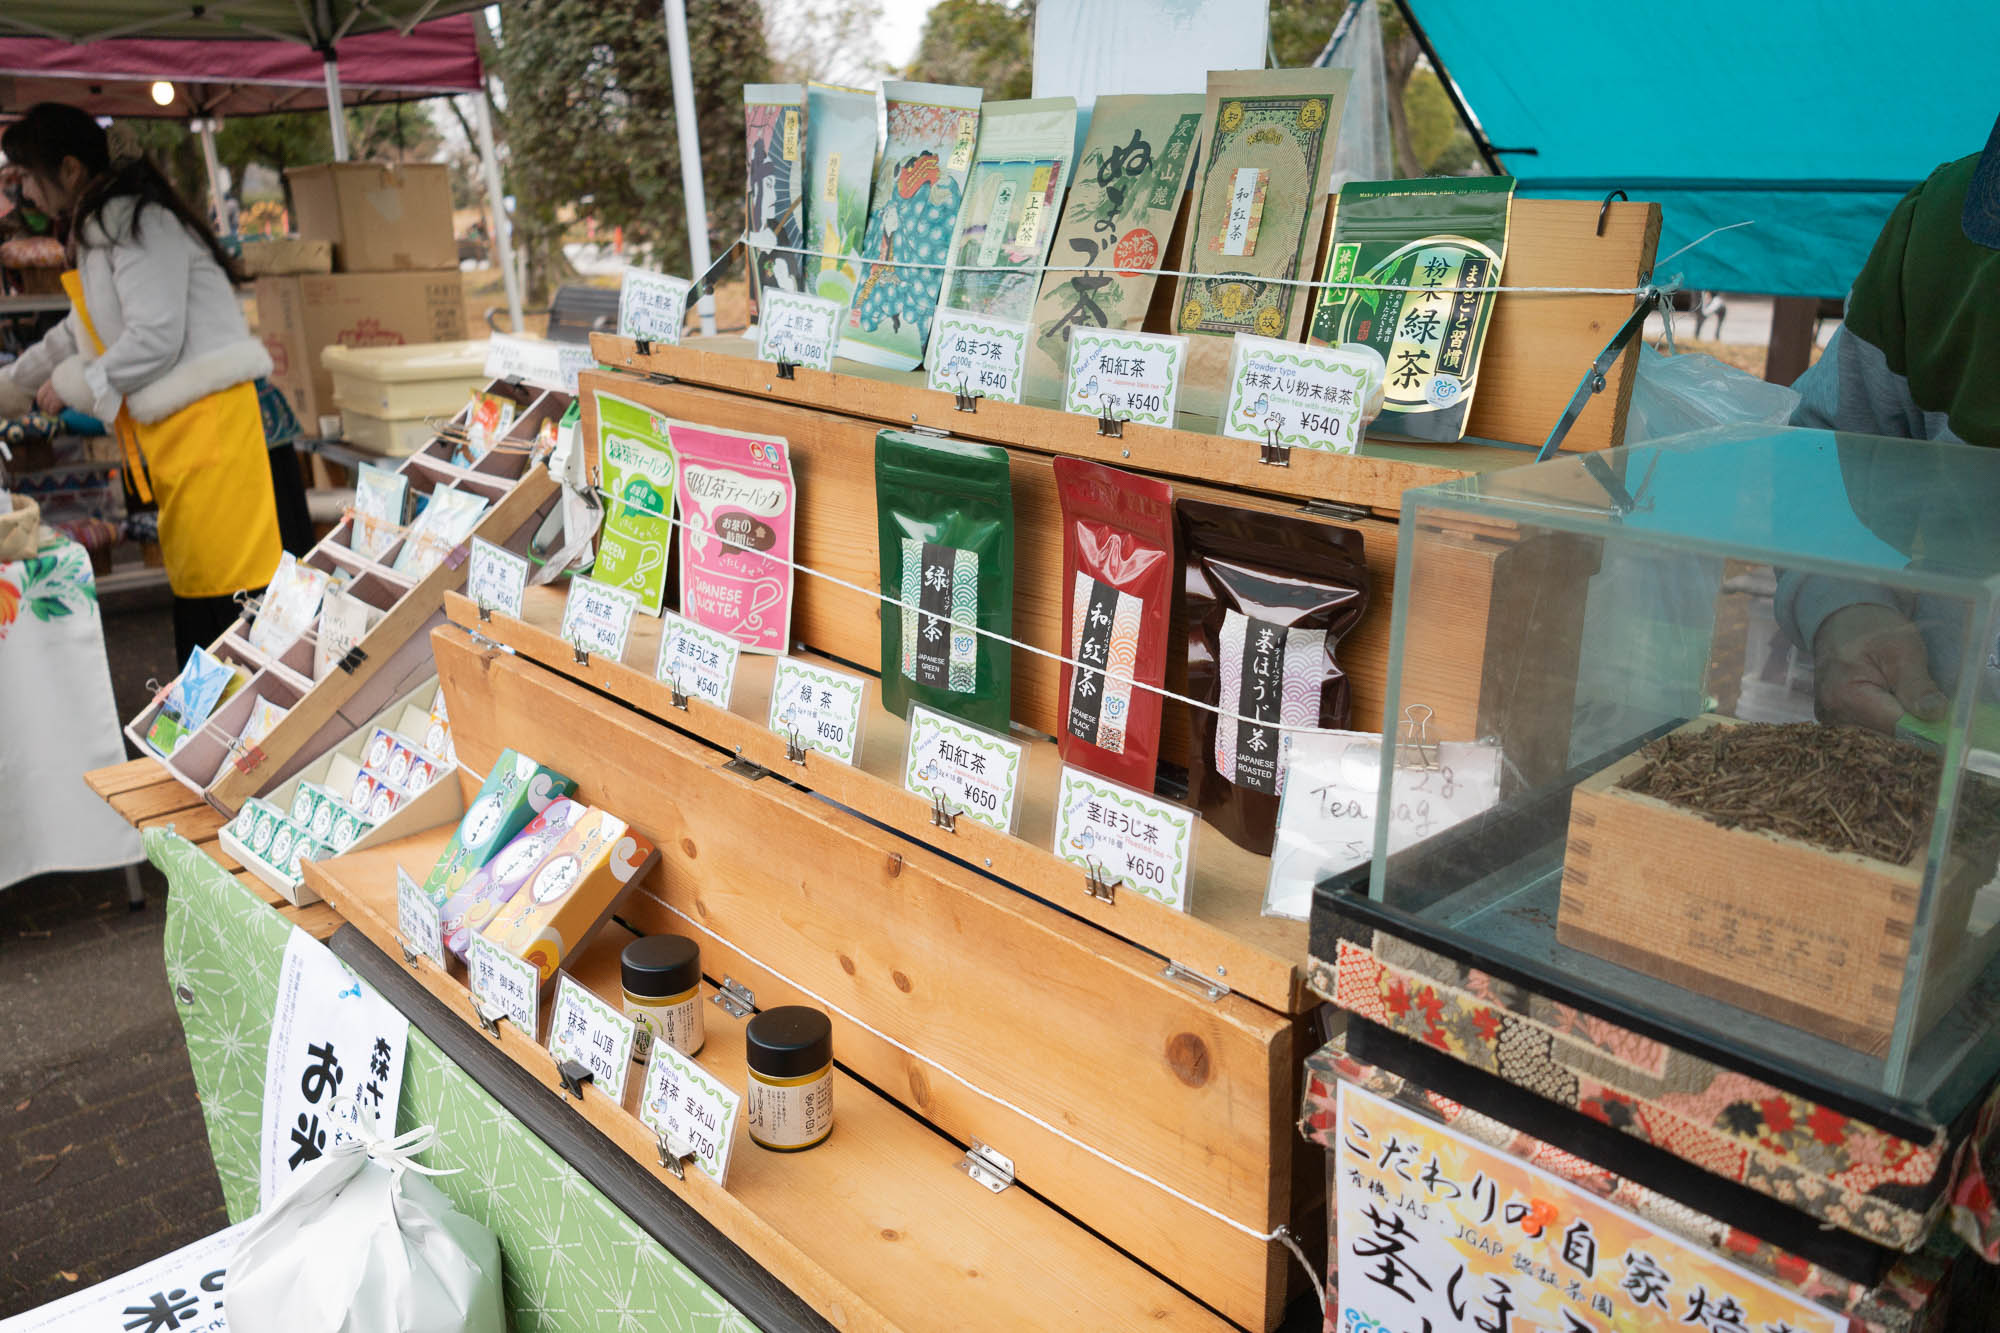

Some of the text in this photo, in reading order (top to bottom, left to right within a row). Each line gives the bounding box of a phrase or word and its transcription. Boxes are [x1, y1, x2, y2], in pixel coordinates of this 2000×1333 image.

[1229, 187, 1250, 241] 和紅茶
[1376, 277, 1398, 343] 丸といただきます
[1383, 278, 1407, 343] 日の恵みを、毎日
[1392, 256, 1451, 389] 粉末緑茶
[955, 336, 1004, 360] ぬまづ茶
[1098, 355, 1146, 378] 和紅茶
[1249, 359, 1297, 377] Powder type
[979, 369, 1007, 390] ¥540
[1245, 371, 1353, 406] 抹茶入り粉末緑茶
[1127, 392, 1160, 412] ¥540
[1300, 411, 1340, 436] ¥540
[721, 517, 752, 533] お茶の
[585, 597, 613, 621] 和紅茶
[717, 601, 740, 619] TEA
[923, 565, 947, 643] 緑茶
[597, 627, 617, 646] ¥540
[677, 637, 720, 670] 茎ほうじ茶
[918, 653, 945, 665] JAPANESE
[1077, 602, 1109, 697] 和紅茶
[921, 662, 940, 673] GREEN
[925, 671, 936, 681] TEA
[696, 674, 719, 697] ¥540
[1246, 627, 1274, 752] 茎ほうじ茶
[1071, 707, 1097, 724] JAPANESE
[1072, 717, 1090, 730] BLACK
[817, 719, 844, 743] ¥650
[1074, 727, 1085, 739] TEA
[938, 739, 987, 775] 和紅茶
[1237, 753, 1275, 769] JAPANESE
[1237, 763, 1273, 779] ROASTED
[1246, 775, 1261, 787] TEA
[964, 781, 998, 811] ¥650
[1310, 784, 1369, 820] Tea
[1087, 800, 1159, 846] 茎ほうじ茶
[1126, 852, 1165, 884] ¥650
[568, 1008, 615, 1057] 抹茶 山頂
[589, 1051, 613, 1080] ¥970
[660, 1075, 717, 1132] 抹茶 宝永山
[688, 1127, 715, 1160] ¥750
[1345, 1120, 1798, 1333] こだわりの自家焙
